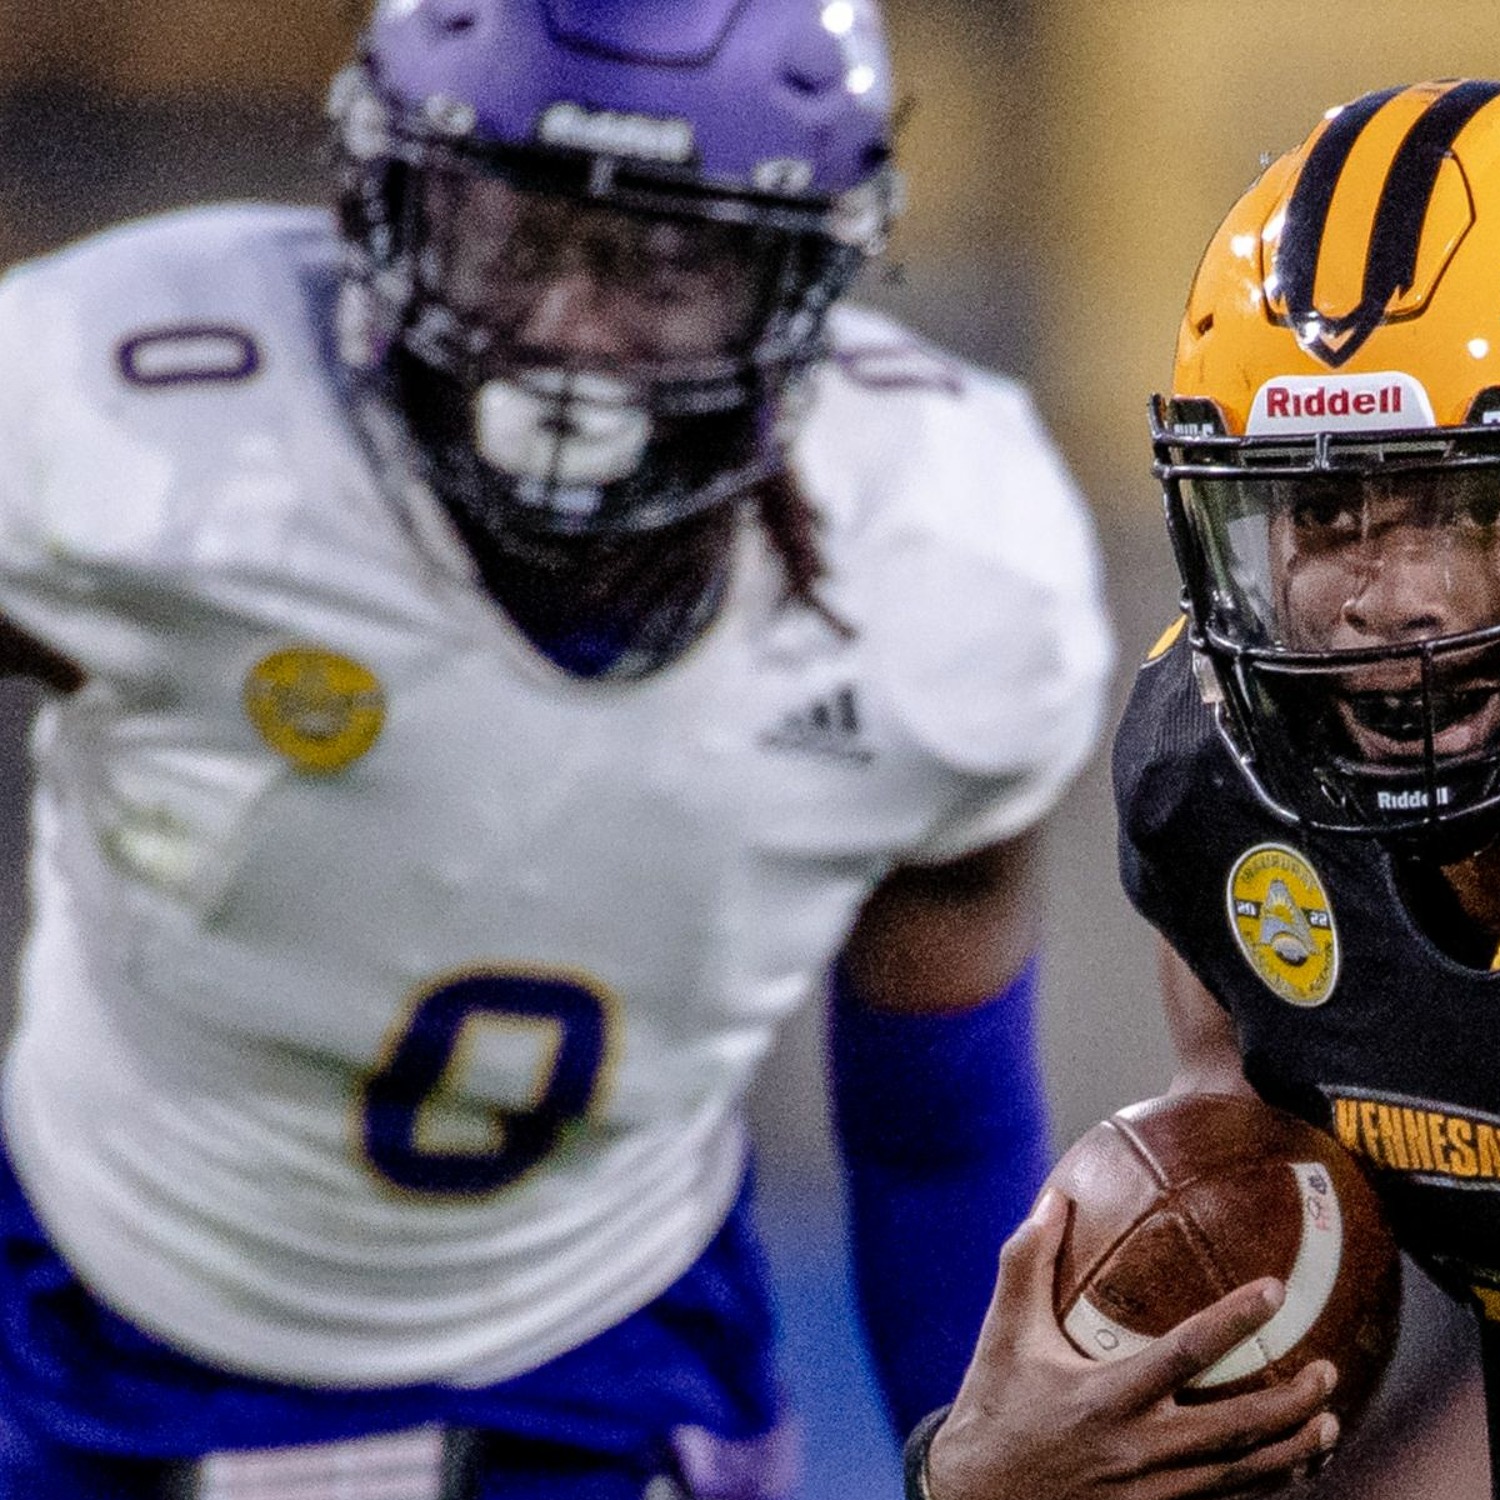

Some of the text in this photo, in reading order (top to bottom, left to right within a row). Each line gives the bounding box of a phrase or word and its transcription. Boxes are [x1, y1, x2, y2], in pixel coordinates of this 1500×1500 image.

[118, 324, 263, 388] 0
[1266, 386, 1402, 418] Riddell
[352, 960, 620, 1202] 0
